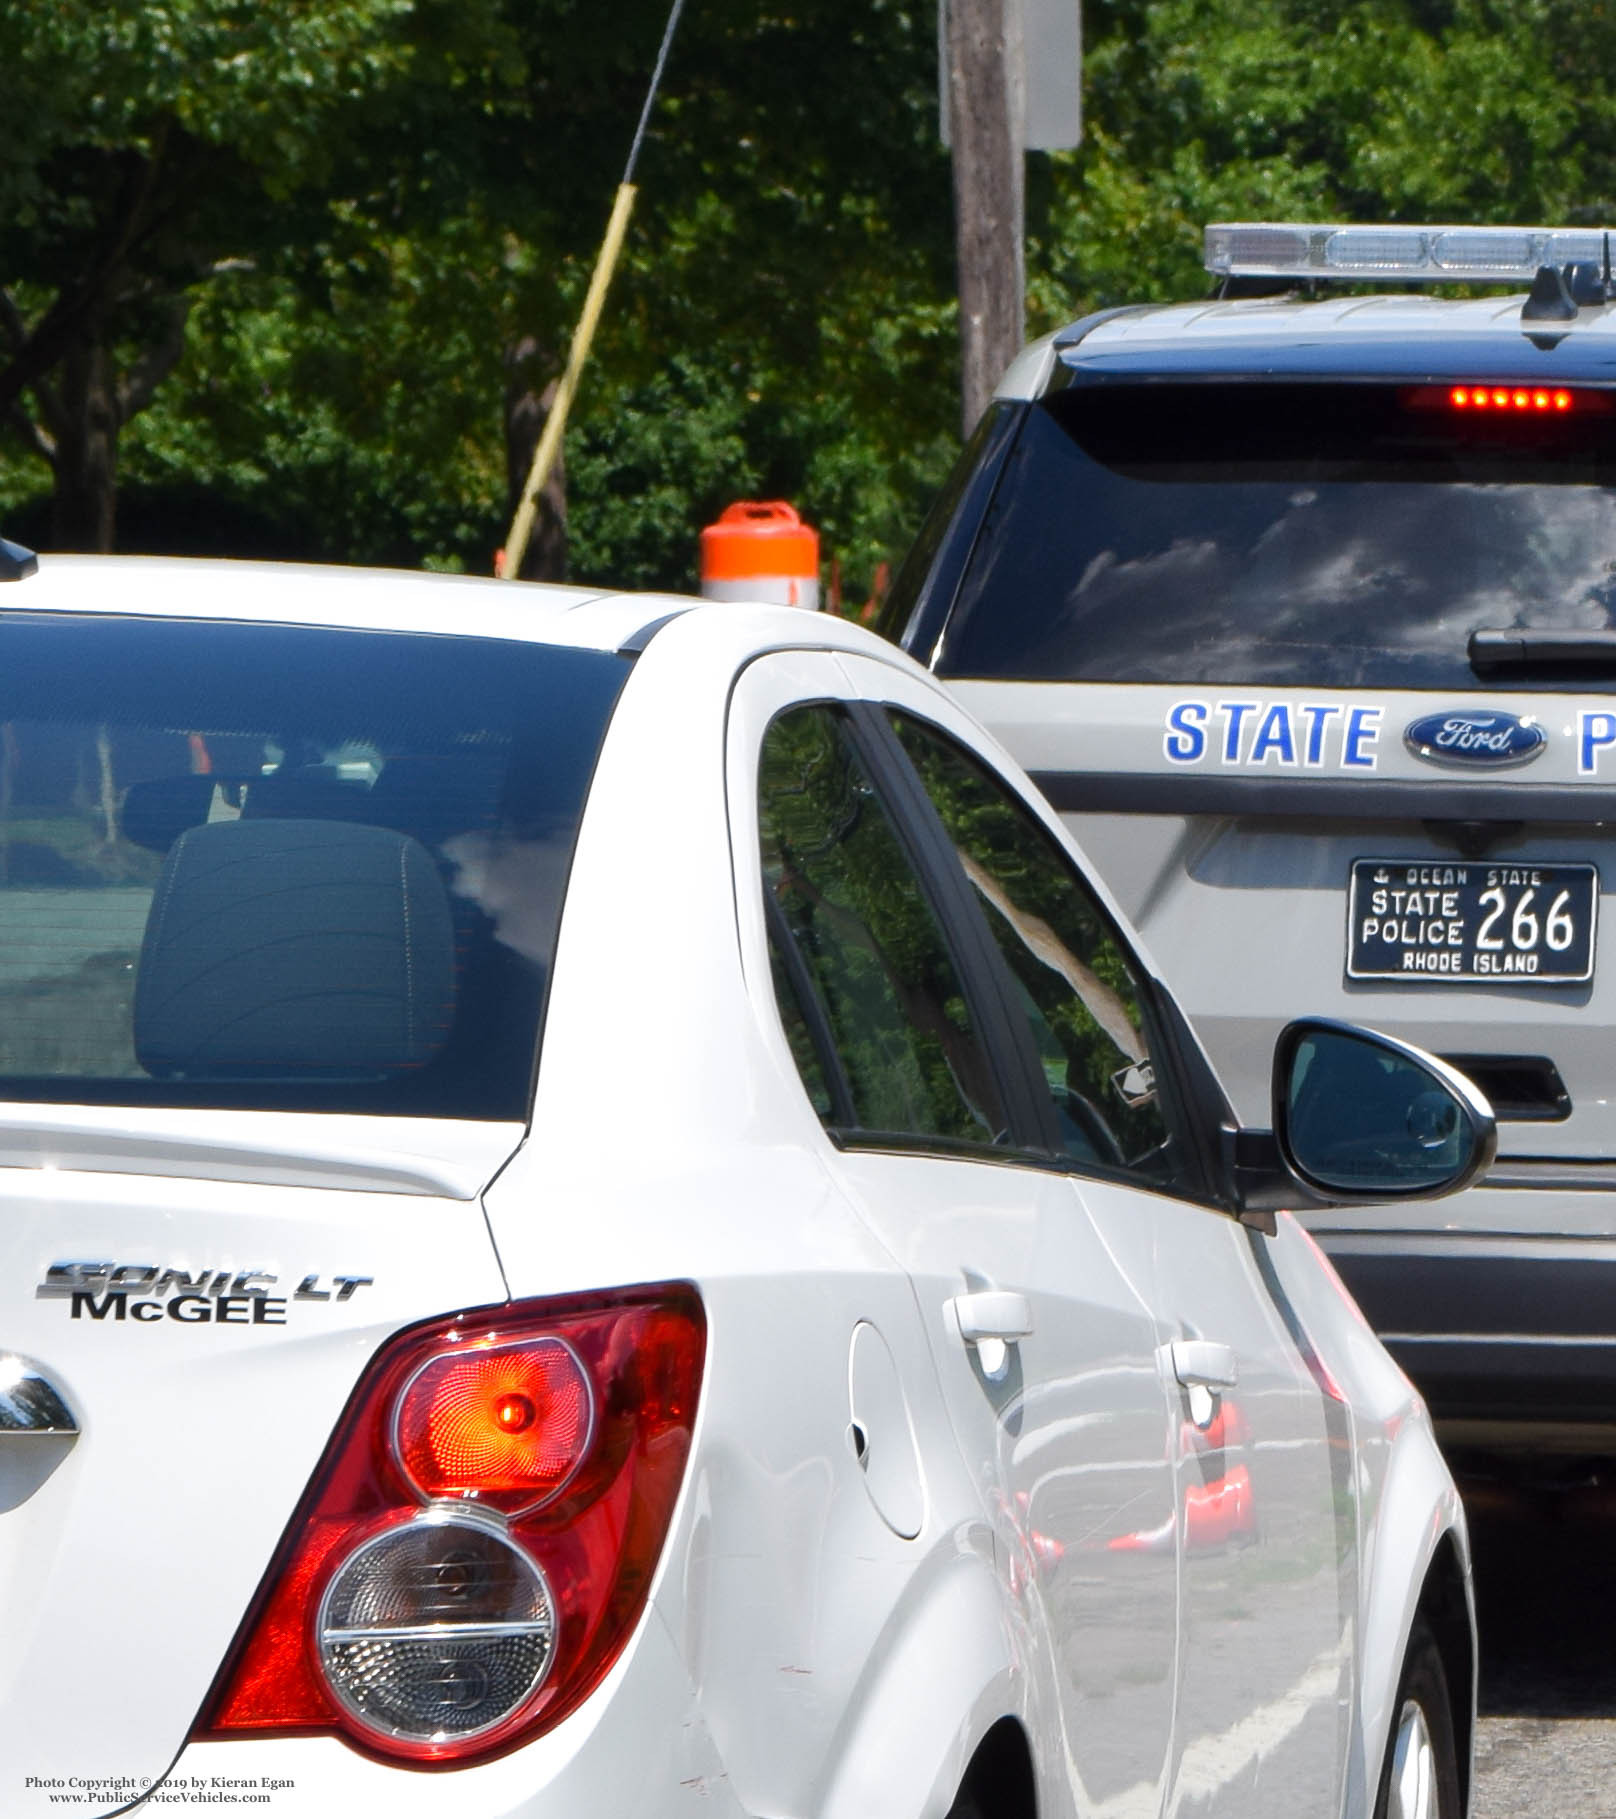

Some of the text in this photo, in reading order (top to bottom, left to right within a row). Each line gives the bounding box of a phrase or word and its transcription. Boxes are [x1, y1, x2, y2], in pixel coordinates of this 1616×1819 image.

[1164, 701, 1384, 769] STATE
[1436, 718, 1511, 750] Ford
[1407, 868, 1542, 886] OCEAN STATE
[1372, 889, 1460, 917] STATE
[1476, 887, 1573, 950] 266
[1363, 918, 1464, 945] POLICE
[1403, 952, 1539, 974] RHODE ISLAND
[36, 1258, 374, 1301] SONIC LT
[70, 1292, 288, 1325] McGEE
